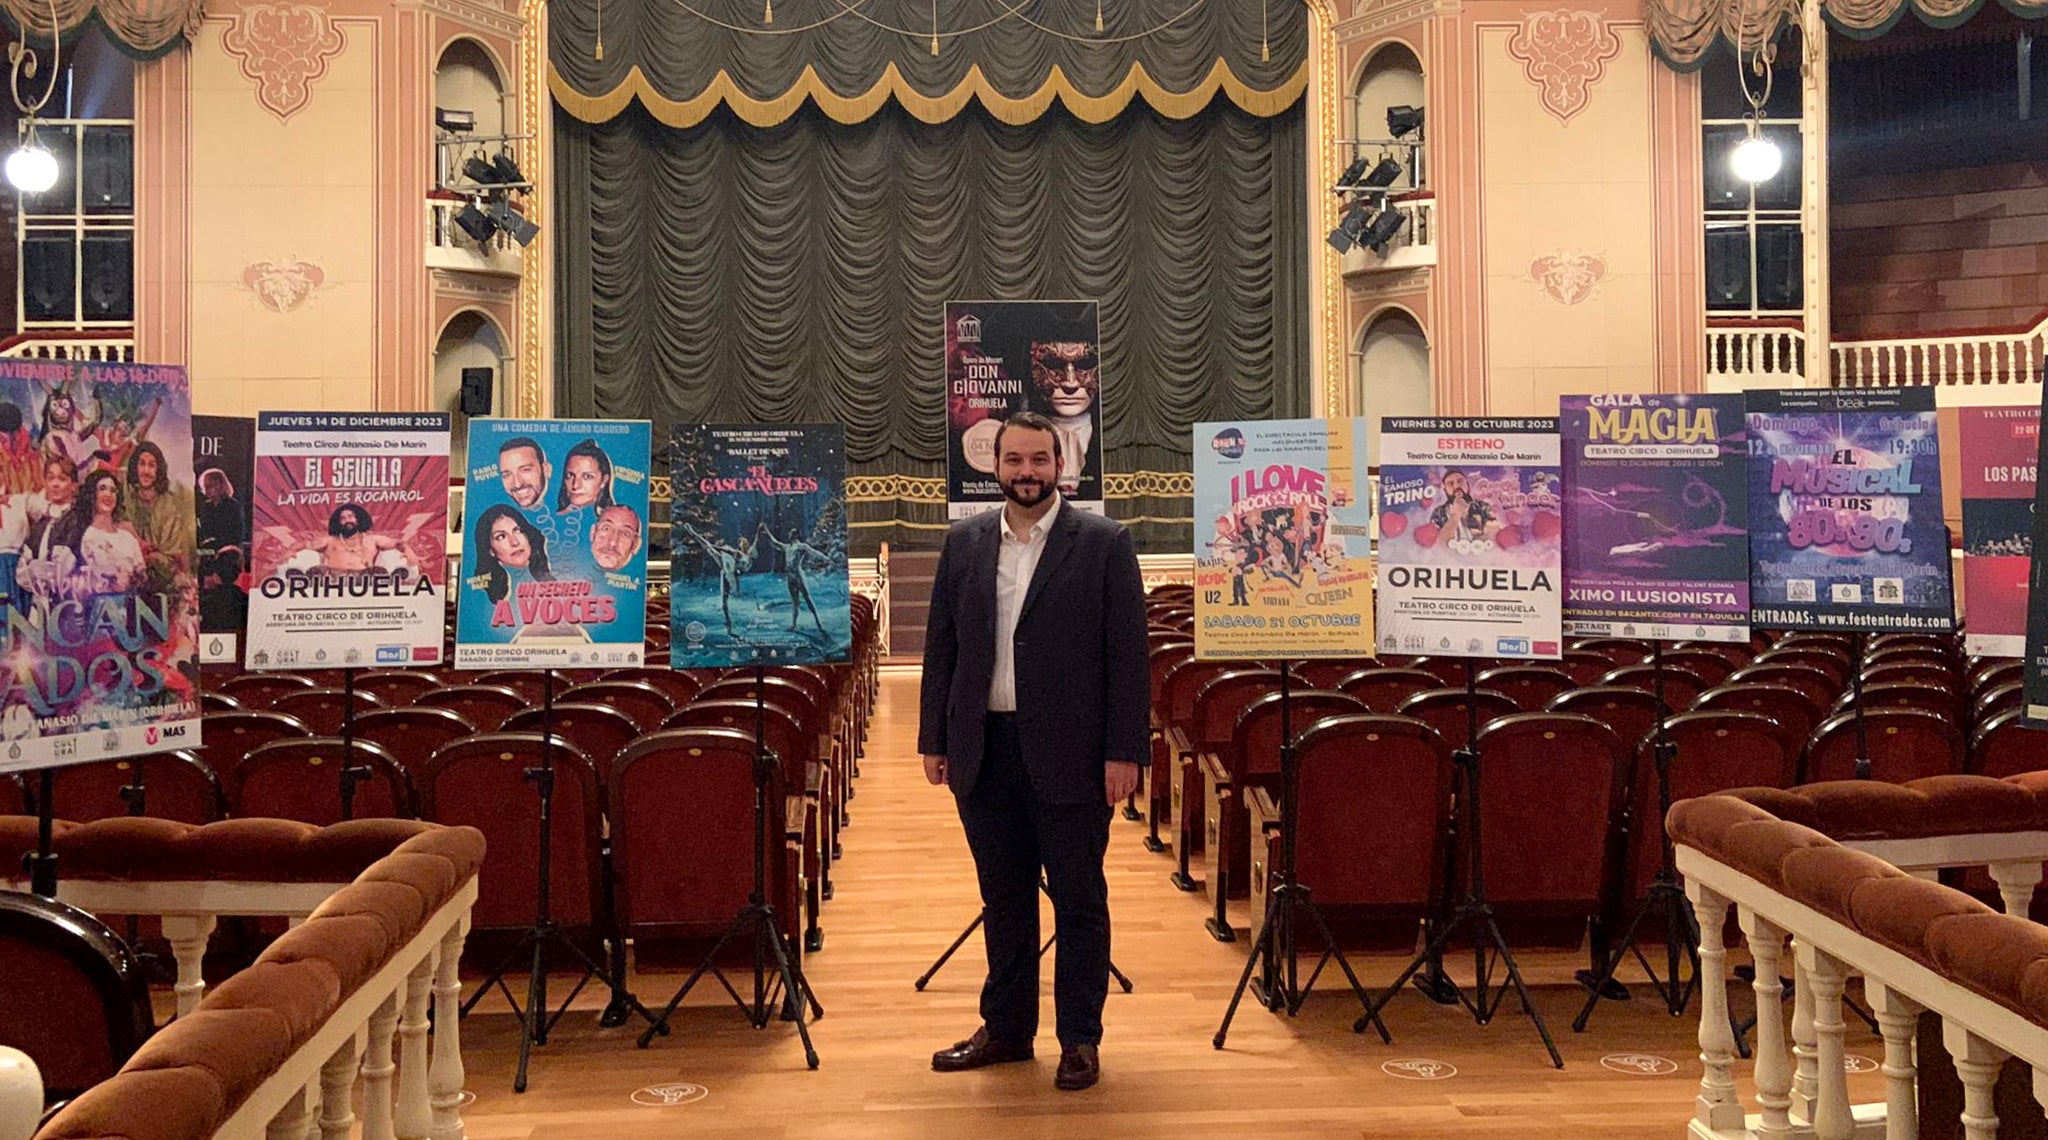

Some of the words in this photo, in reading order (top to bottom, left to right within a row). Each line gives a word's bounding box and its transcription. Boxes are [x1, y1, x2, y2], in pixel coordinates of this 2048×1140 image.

[0, 362, 75, 380] VIEMBRE
[969, 365, 998, 379] DON
[954, 379, 1022, 396] GIOVANNI
[968, 398, 1008, 409] ORIHUELA
[1590, 394, 1642, 407] GALA
[268, 417, 312, 426] JUEVES
[316, 417, 328, 426] 14
[331, 417, 347, 426] DE
[350, 417, 412, 427] DICIEMBRE
[415, 417, 442, 427] 2023
[492, 423, 509, 432] UNA
[511, 423, 547, 433] COMEDIA
[550, 424, 559, 433] DE
[1391, 419, 1436, 428] VIERNES
[1439, 420, 1453, 428] 20
[1456, 420, 1470, 428] DE
[1473, 420, 1524, 428] OCTUBRE
[1527, 420, 1554, 429] 2023
[1585, 405, 1717, 444] MAGIA
[1752, 413, 1818, 435] Domingo
[1879, 416, 1929, 431] Orihuela
[201, 436, 223, 456] DE
[283, 440, 312, 449] Teatro
[314, 440, 340, 449] Circo
[342, 440, 382, 449] Atanasio
[1437, 438, 1505, 450] ESTRENO
[1747, 440, 1763, 456] 12
[1889, 438, 1937, 455] 19:30h
[1407, 452, 1433, 460] Teatro
[1435, 452, 1459, 460] Circo
[1461, 452, 1499, 460] Atanasio
[1831, 449, 1857, 465] EL
[1245, 464, 1326, 498] LOVE
[1771, 459, 1922, 494] MUSICAL
[1984, 466, 2009, 482] LOS
[2011, 466, 2037, 482] PAS
[1384, 478, 1424, 493] FAMOSO
[277, 493, 295, 506] LA
[301, 491, 330, 505] VIDA
[335, 491, 350, 504] ES
[354, 489, 425, 504] ROCANROL
[1239, 492, 1272, 514] ROCK
[1289, 492, 1326, 512] ROLL
[1384, 485, 1437, 506] TRINO
[1819, 498, 1834, 508] DE
[1840, 498, 1873, 511] LOS
[1388, 566, 1553, 591] ORIHUELA
[261, 574, 435, 600] ORIHUELA
[1205, 591, 1221, 604] U2
[1305, 588, 1353, 606] QUEEN
[1569, 588, 1615, 601] XIMO
[1621, 589, 1737, 605] ILUSIONISTA
[491, 600, 515, 627] A
[519, 596, 617, 625] VOCES
[1399, 602, 1436, 610] TEATRO
[1439, 603, 1468, 611] CIRCO
[1471, 603, 1483, 611] DE
[1486, 604, 1536, 612] ORIHUELA
[0, 590, 170, 656] NCAN
[272, 612, 313, 621] TEATRO
[316, 612, 347, 621] CIRCO
[350, 612, 363, 620] DE
[367, 611, 417, 620] ORIHUELA
[1269, 617, 1285, 628] 21
[1288, 614, 1361, 628] OCTUBRE
[1704, 612, 1746, 621] TAQUILLA
[1751, 610, 1814, 624] ENTRADAS:
[1818, 612, 1951, 628] www.festentradas.com
[459, 648, 493, 656] TEATRO
[163, 726, 186, 738] MAS
